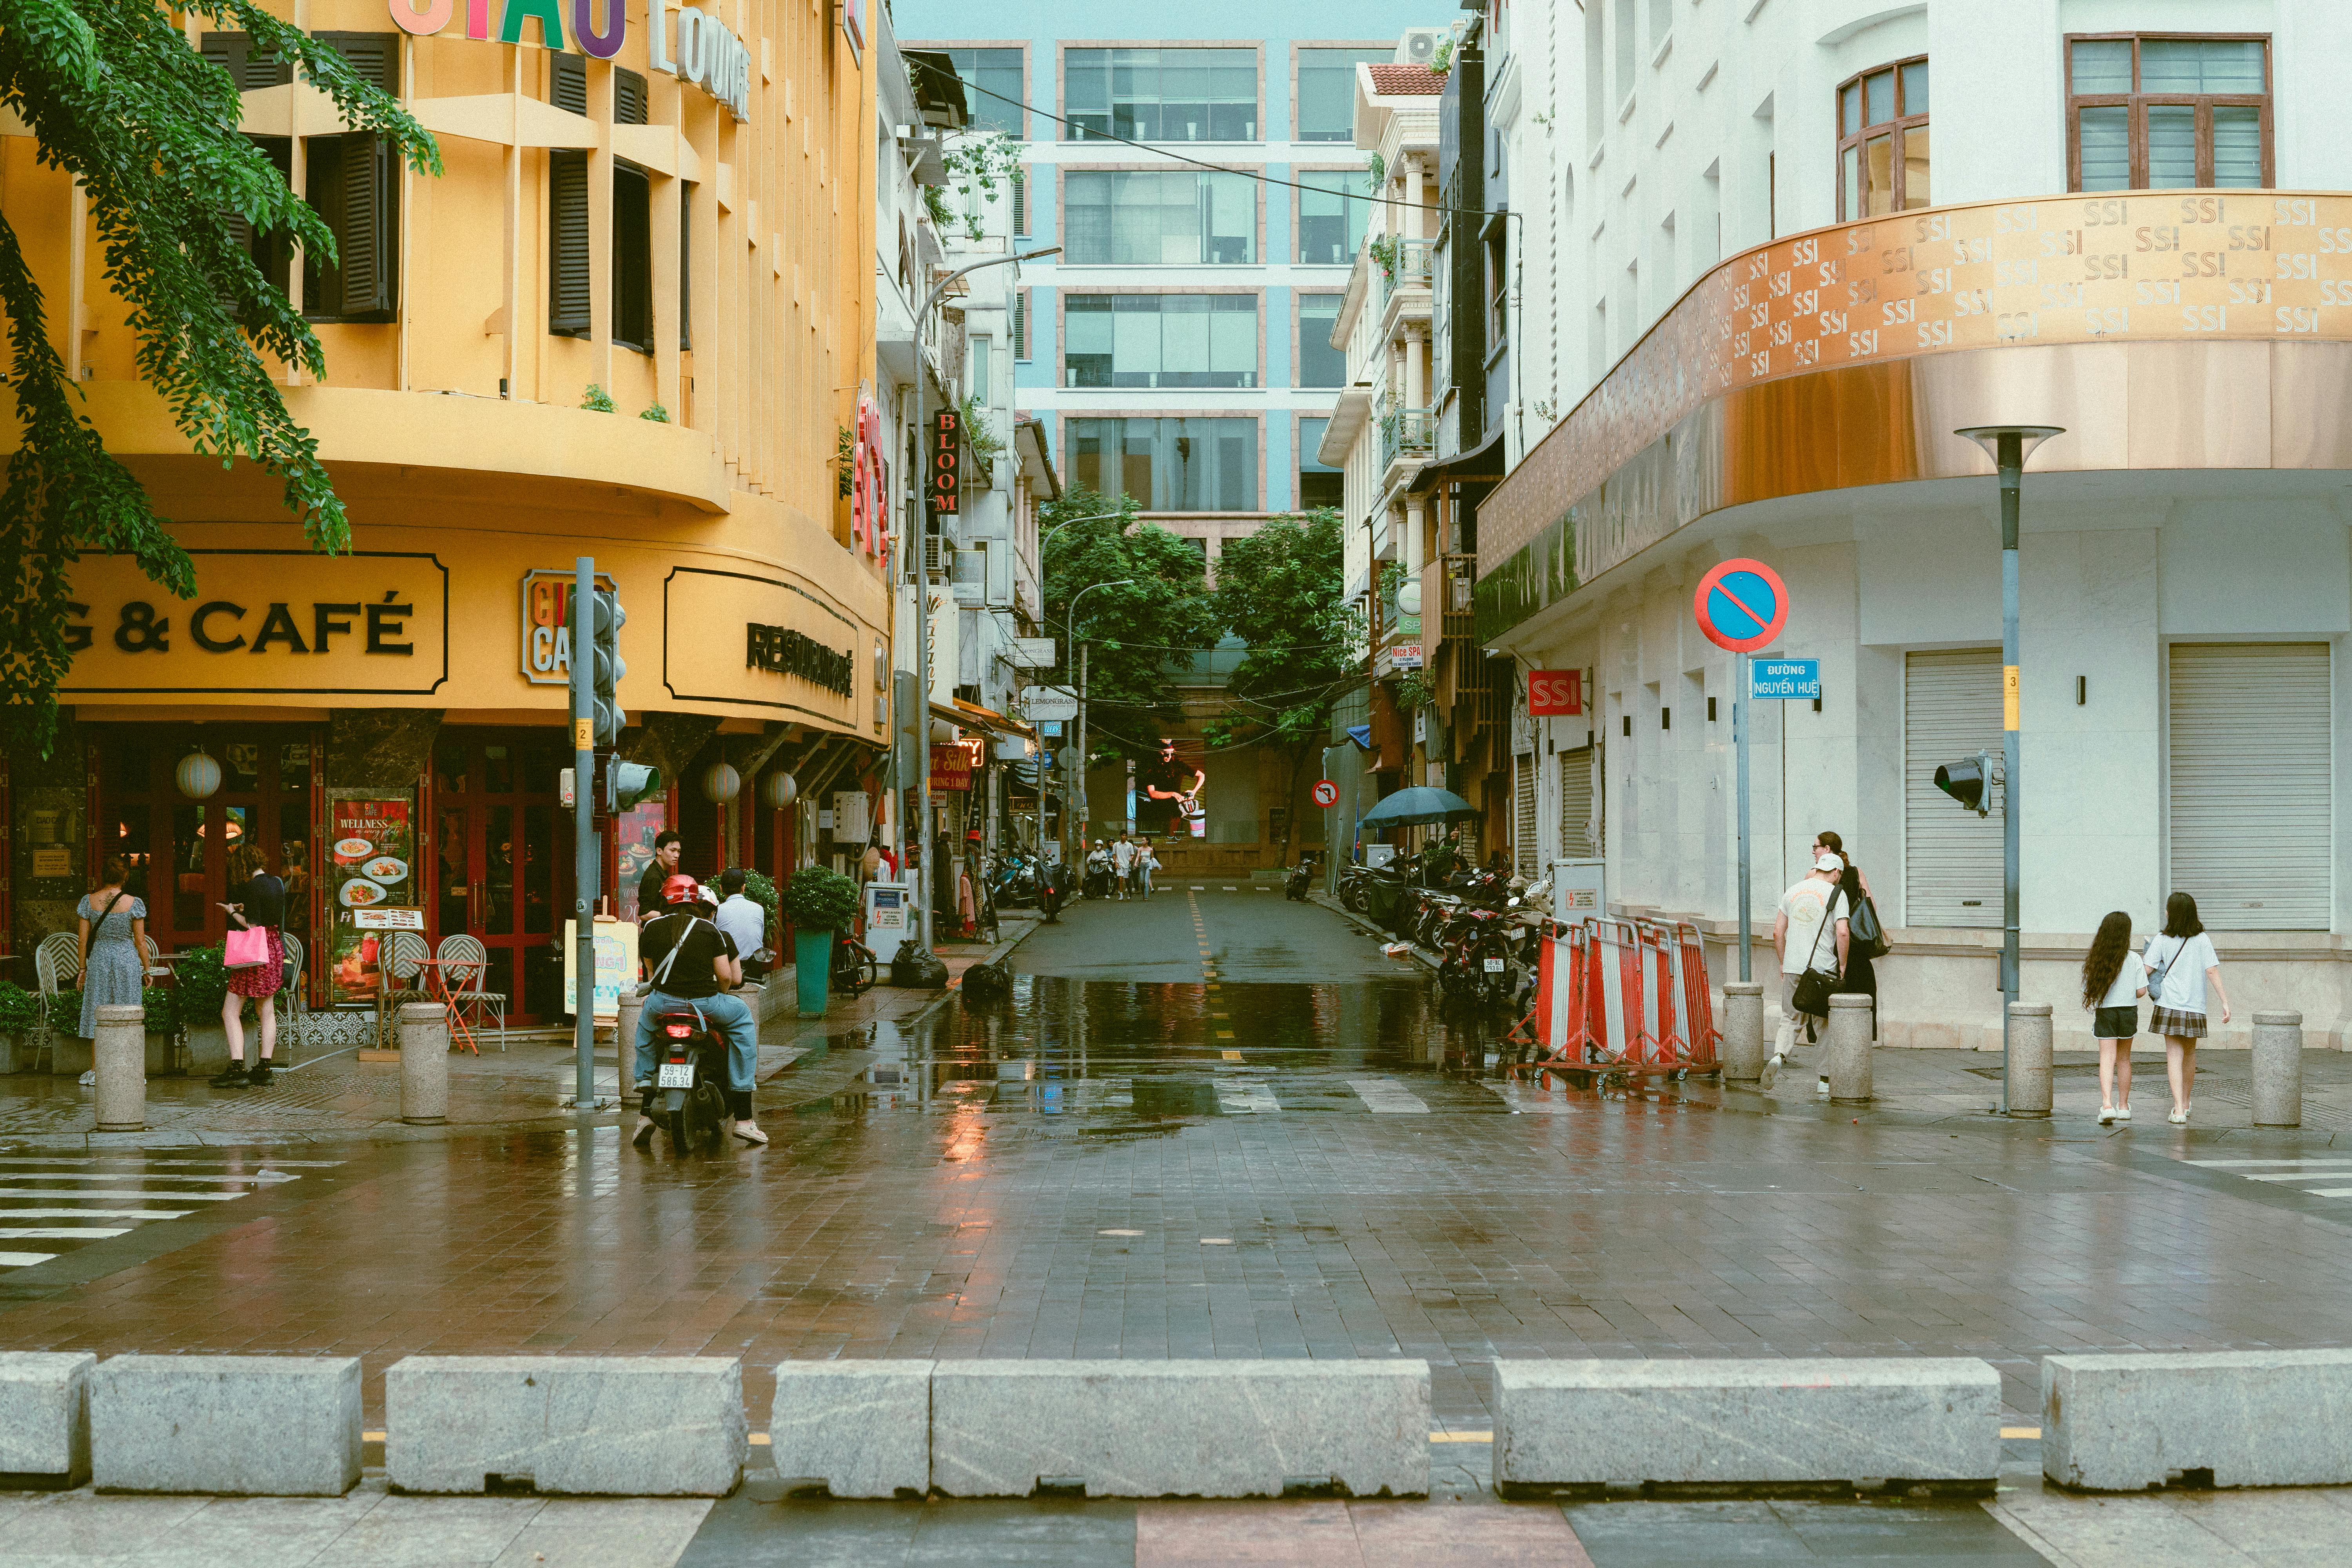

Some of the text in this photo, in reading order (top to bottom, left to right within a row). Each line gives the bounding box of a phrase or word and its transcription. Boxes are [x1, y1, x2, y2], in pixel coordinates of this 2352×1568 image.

[649, 0, 750, 124] LOUNGE
[1996, 206, 2036, 234] SSI
[2085, 201, 2127, 227] SSI
[2181, 198, 2224, 223] SSI
[2275, 200, 2315, 226] SSI
[1847, 227, 1876, 255] SSI
[1916, 216, 1950, 243] SSI
[2136, 226, 2179, 252] SSI
[2229, 225, 2270, 251] SSI
[2319, 228, 2352, 253] SS
[1793, 239, 1818, 267] SSI
[1954, 238, 1991, 265] SSI
[2040, 230, 2082, 257] SSI
[1750, 252, 1768, 280] SSI
[1820, 259, 1846, 286] SSI
[1882, 247, 1914, 274] SSI
[1996, 259, 2037, 286] SSI
[2085, 254, 2127, 280] SSI
[2183, 252, 2225, 277] SSI
[2276, 253, 2316, 279] SSI
[1769, 270, 1791, 298] SSI
[1848, 278, 1877, 306] SSI
[1916, 268, 1951, 295] SSI
[2136, 279, 2180, 305] SSI
[2229, 278, 2271, 303] SSI
[2321, 280, 2352, 305] SS
[1734, 284, 1749, 311] SSI
[1793, 289, 1818, 316] SSI
[1955, 289, 1992, 316] SSI
[2041, 282, 2082, 309] SSI
[1750, 301, 1768, 329] SSI
[1820, 310, 1847, 336] SSI
[1883, 298, 1915, 325] SSI
[2085, 307, 2128, 334] SSI
[2183, 305, 2225, 331] SSI
[2276, 307, 2317, 332] SSI
[1769, 320, 1791, 347] SSI
[1918, 320, 1952, 347] SSI
[1997, 312, 2037, 339] SSI
[1734, 331, 1749, 357] SSI
[1795, 339, 1818, 365] SSI
[1849, 329, 1877, 357] SSI
[1750, 350, 1769, 377] SSI
[935, 414, 956, 511] BLOOM
[531, 581, 582, 627] CI
[114, 601, 169, 652] &
[191, 590, 414, 655] CAFÉ
[1405, 621, 1421, 630] SP
[534, 626, 569, 671] CA
[1392, 646, 1421, 657] Nice SPA
[1767, 664, 1805, 675] ĐƯỜNG
[2011, 677, 2016, 687] 3
[1533, 680, 1577, 706] SSI
[1755, 678, 1817, 696] NGUYỄN HUỆ
[580, 729, 586, 739] 2
[944, 750, 969, 771] Silk
[931, 778, 949, 786] ORING
[956, 778, 969, 787] DAY
[341, 819, 387, 828] WELLNESS
[364, 830, 381, 840] every
[380, 826, 403, 840] plate
[340, 912, 352, 922] Fr
[593, 945, 610, 954] UA
[595, 957, 615, 967] NG
[661, 1076, 690, 1086] 586.34
[665, 1066, 689, 1076] 59-T2
